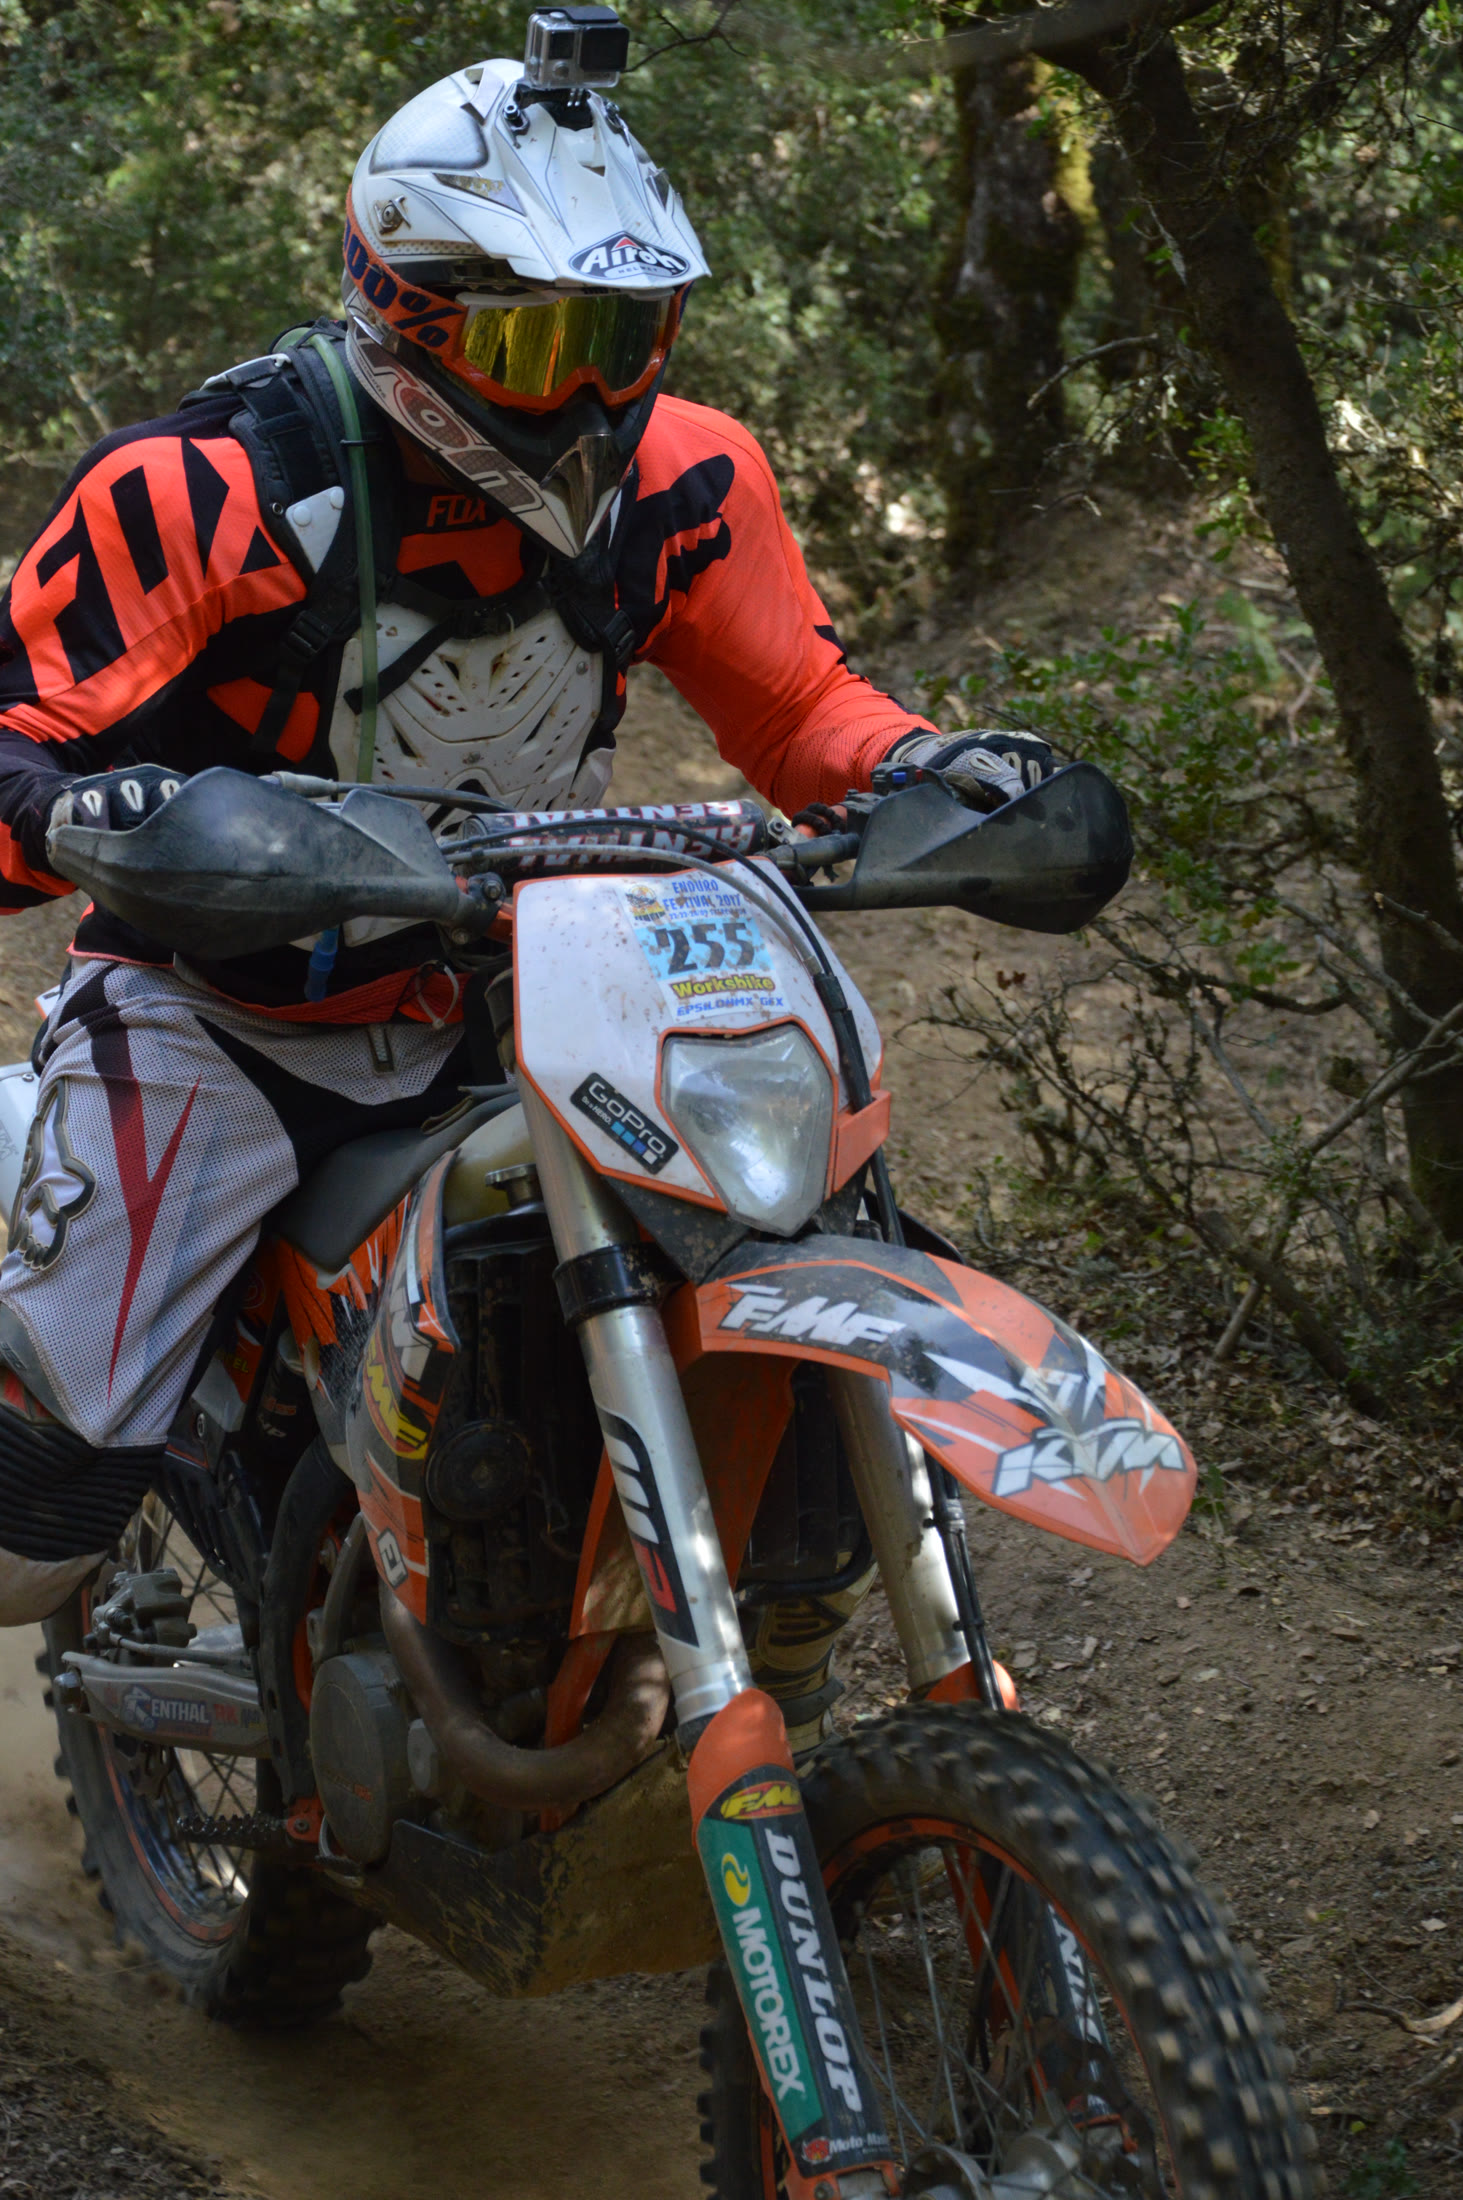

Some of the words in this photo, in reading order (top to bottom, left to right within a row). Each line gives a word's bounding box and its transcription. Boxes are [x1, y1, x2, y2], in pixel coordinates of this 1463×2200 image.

[580, 242, 686, 274] Airoh
[9, 435, 307, 702] FOX
[671, 879, 719, 894] ENDURO
[654, 922, 756, 976] 255
[670, 975, 775, 998] Worksbike
[588, 1080, 666, 1155] GoPro
[720, 1285, 906, 1346] FMF
[993, 1418, 1186, 1497] KTM
[722, 1784, 801, 1820] FM
[764, 1827, 863, 2113] DUNLOP
[732, 1906, 806, 2102] MOTOREX
